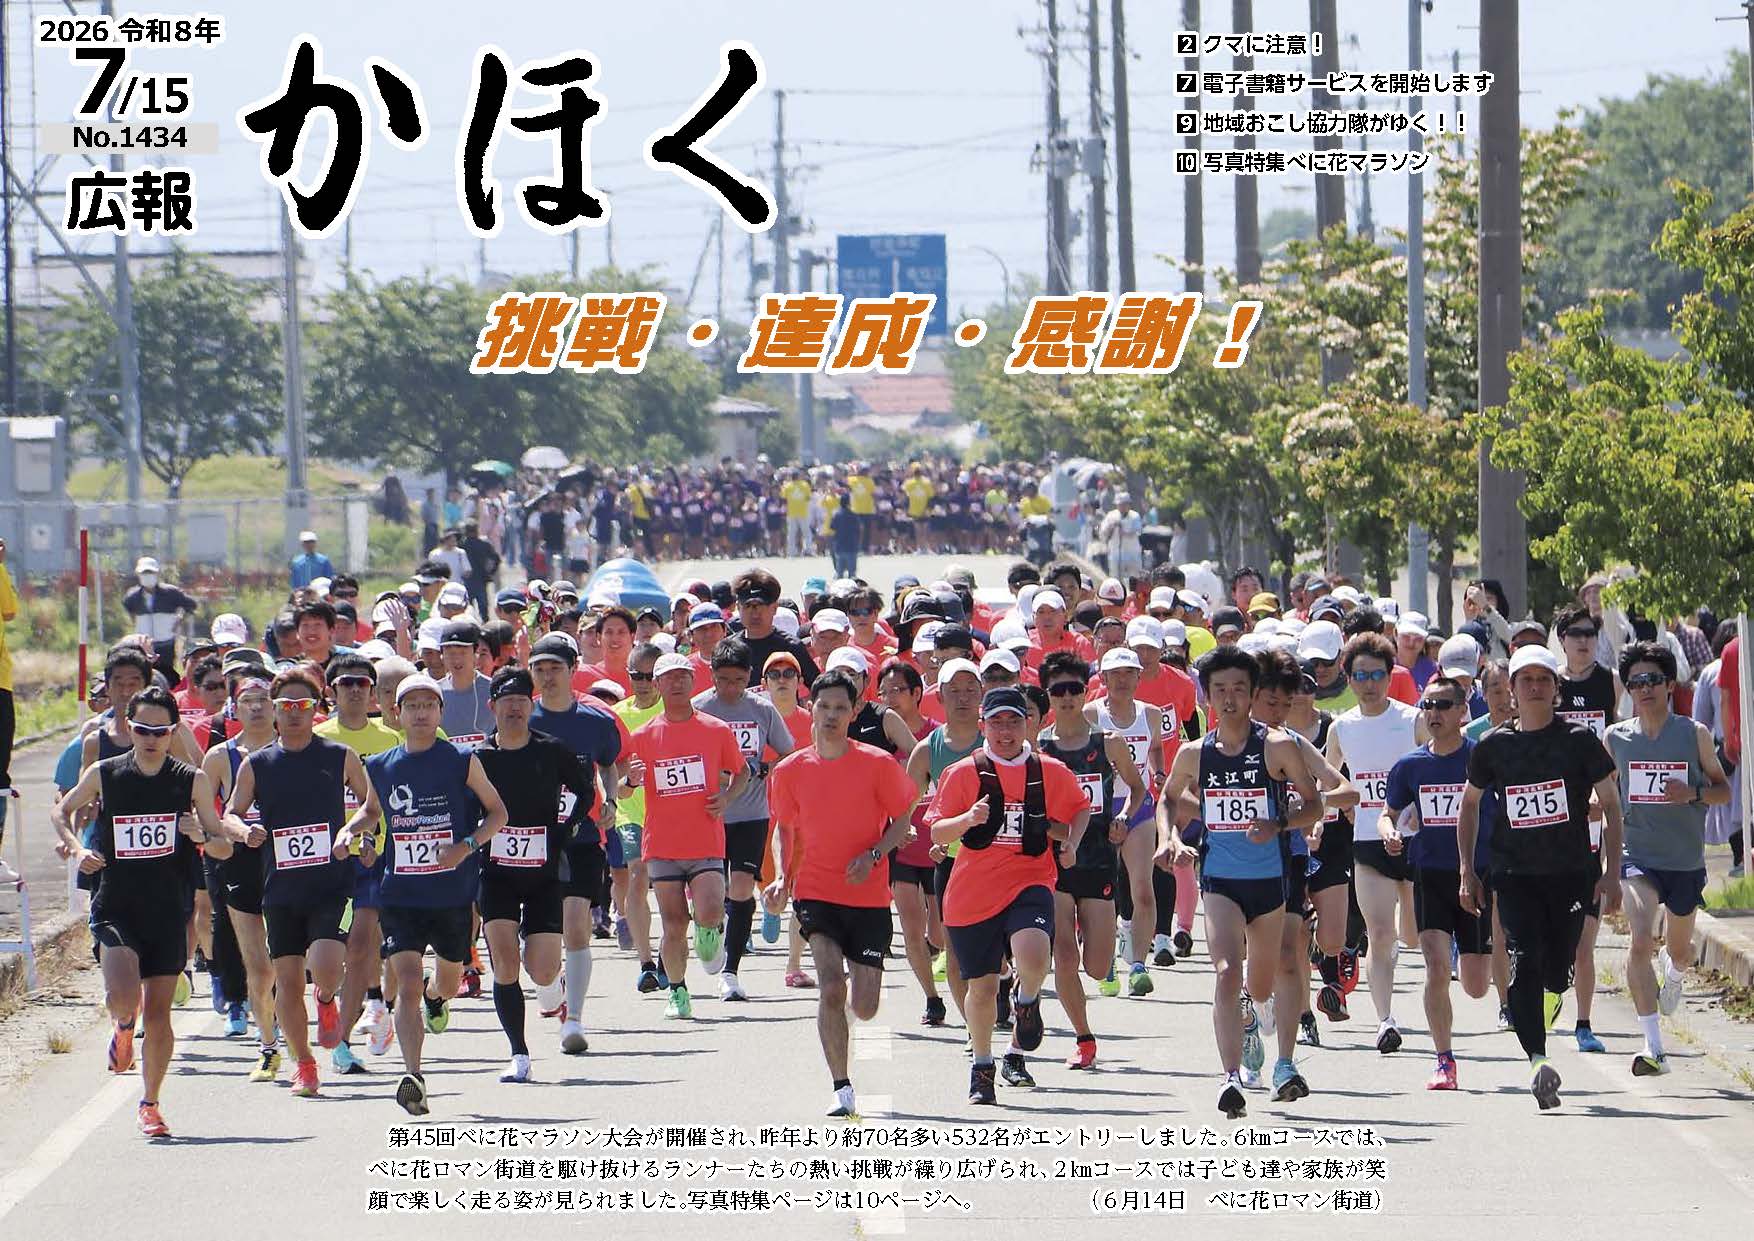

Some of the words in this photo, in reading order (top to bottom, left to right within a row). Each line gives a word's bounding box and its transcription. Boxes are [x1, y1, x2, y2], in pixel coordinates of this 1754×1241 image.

[667, 766, 688, 787] 51
[1208, 770, 1258, 787] 大江町
[1217, 799, 1258, 821] 185
[1516, 792, 1558, 818] 215
[125, 825, 166, 848] 166
[288, 835, 315, 858] 62
[507, 837, 531, 857] 37
